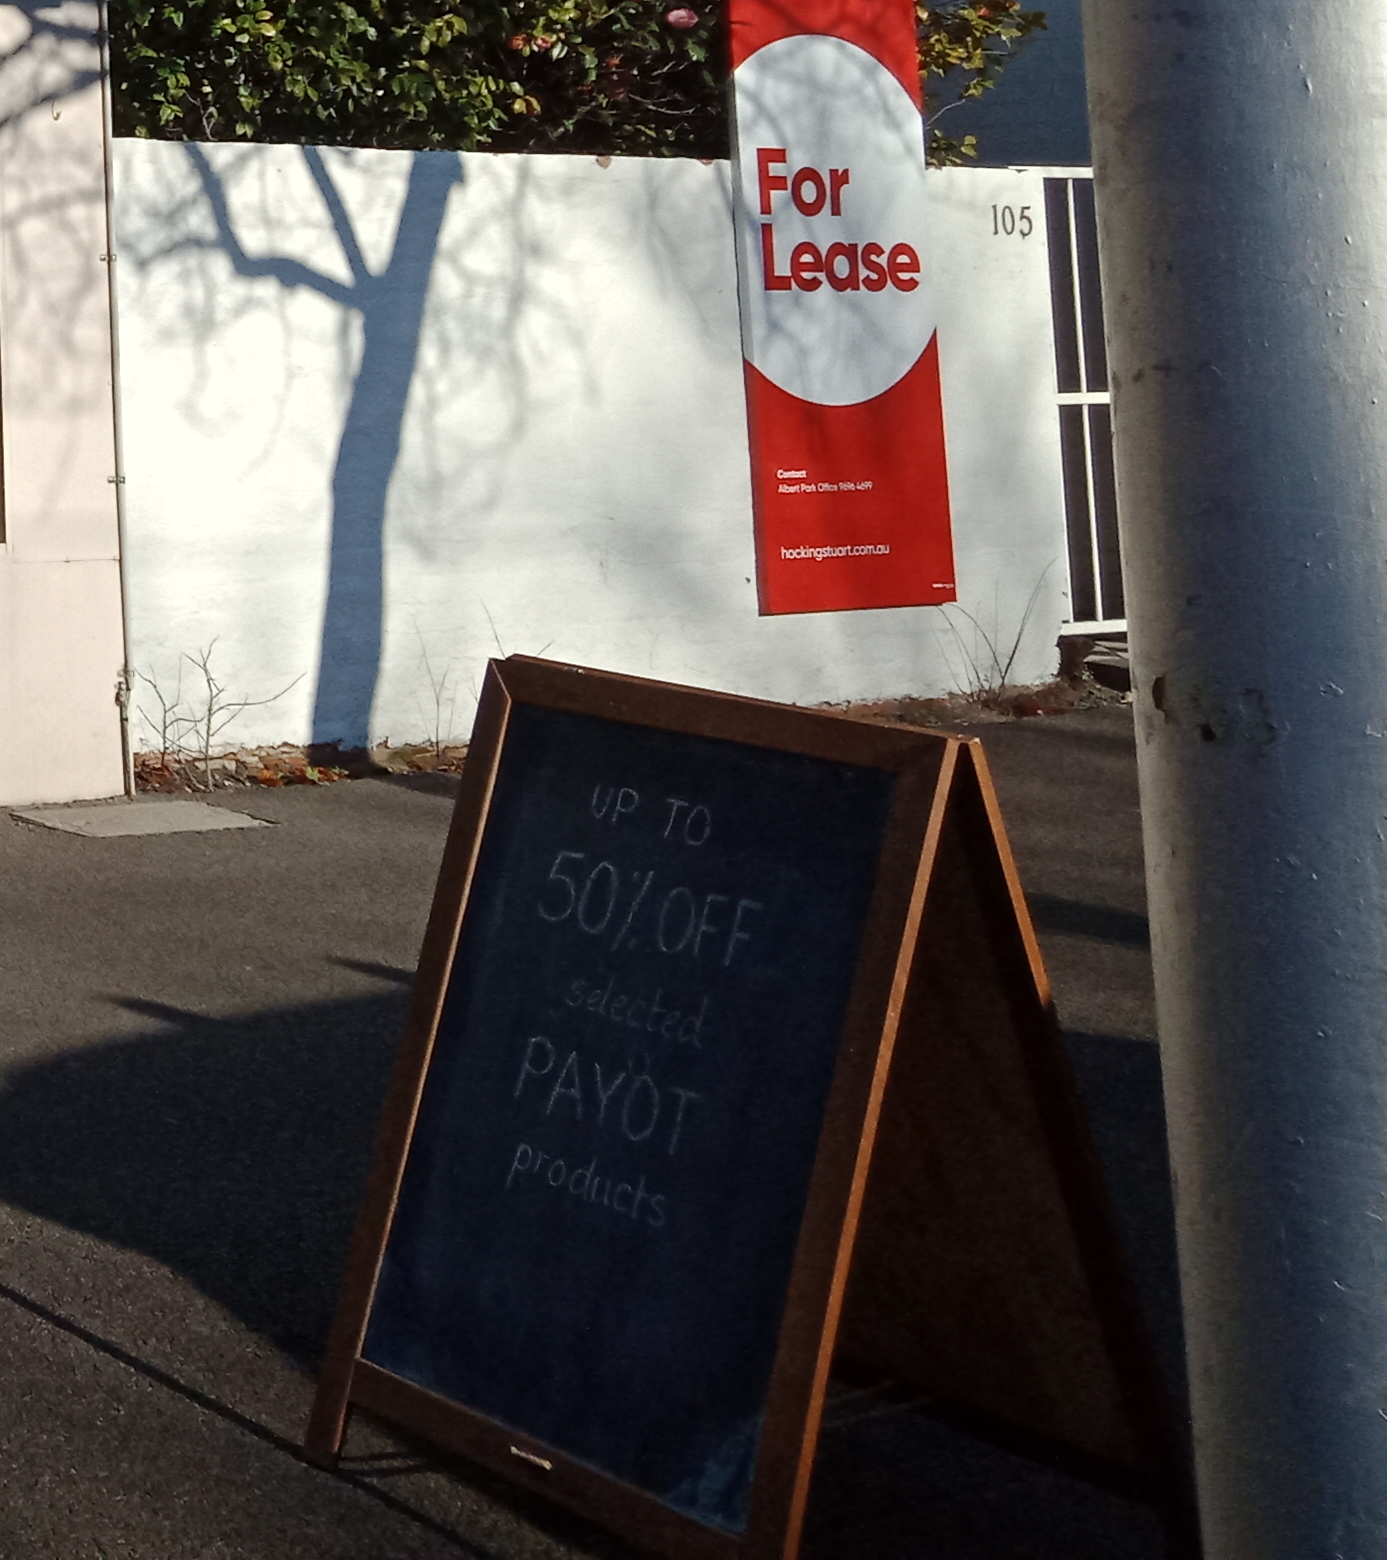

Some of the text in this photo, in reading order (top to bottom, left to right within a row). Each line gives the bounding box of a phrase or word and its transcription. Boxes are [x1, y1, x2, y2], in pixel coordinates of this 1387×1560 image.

[756, 147, 850, 217] For
[991, 203, 1034, 240] 105
[760, 222, 921, 292] Lease
[800, 483, 817, 492] Park
[817, 482, 838, 492] Office
[780, 544, 890, 561] hockingstuart.com.au
[592, 784, 712, 846] UP TO
[563, 975, 709, 1049] selected
[504, 1142, 667, 1229] products
